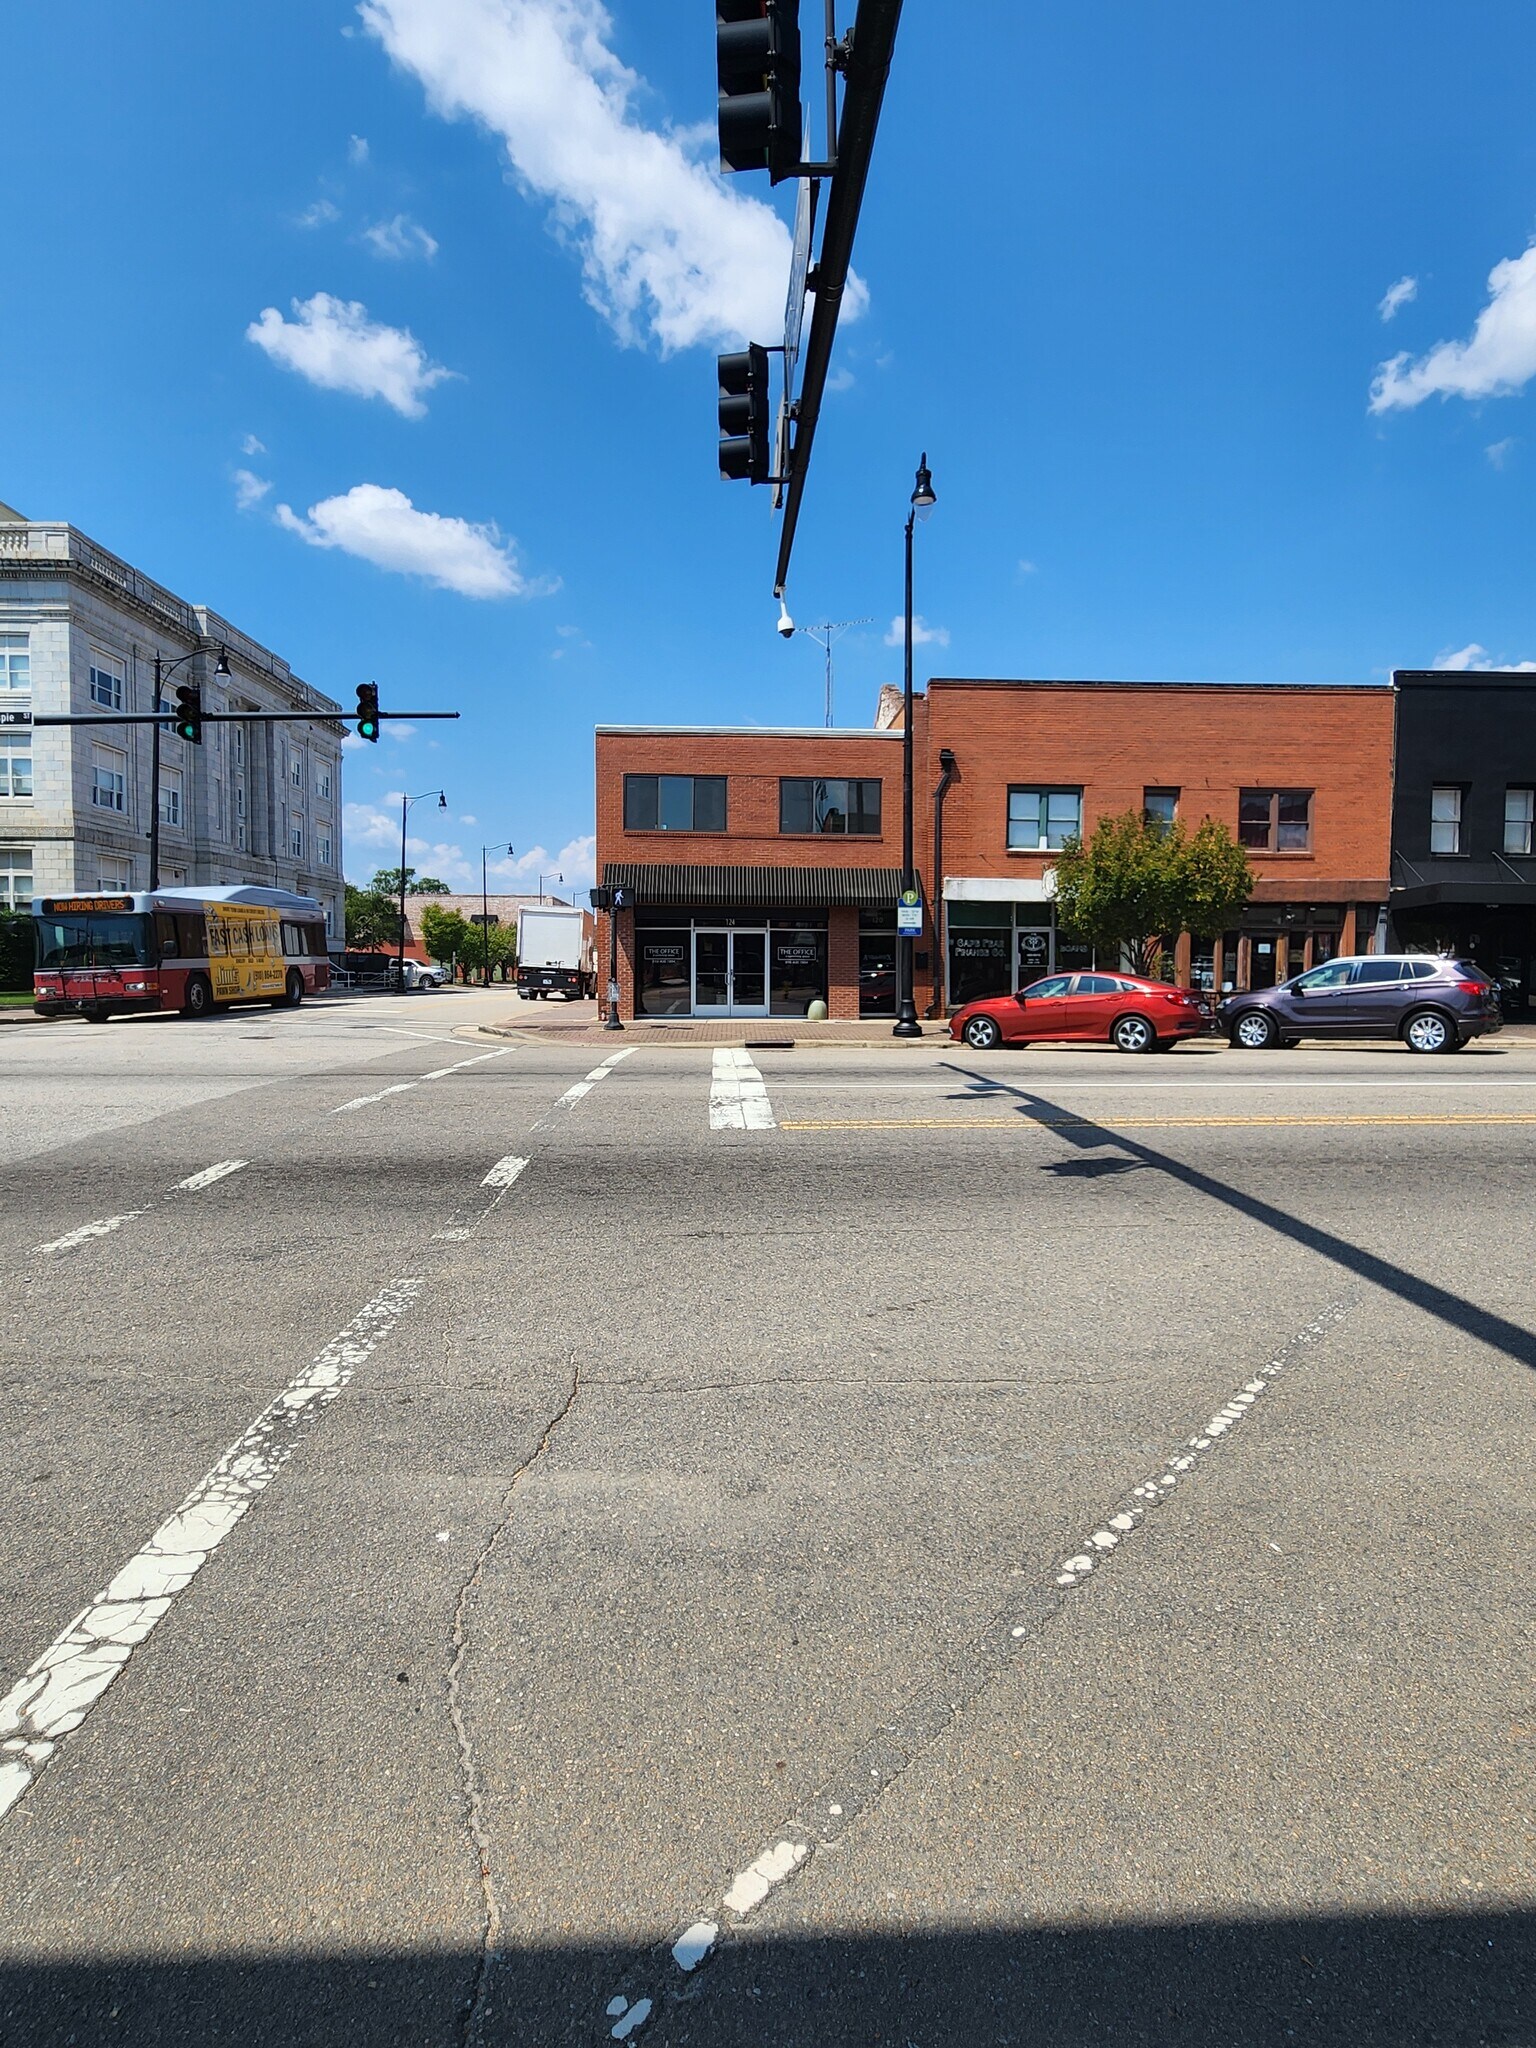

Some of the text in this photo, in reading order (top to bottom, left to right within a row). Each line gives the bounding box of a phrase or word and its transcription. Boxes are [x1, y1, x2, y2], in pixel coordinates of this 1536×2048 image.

[906, 892, 915, 904] P
[53, 900, 125, 912] NOW HIRING DRIVERS
[209, 927, 231, 946] FAST
[232, 926, 255, 945] CASH
